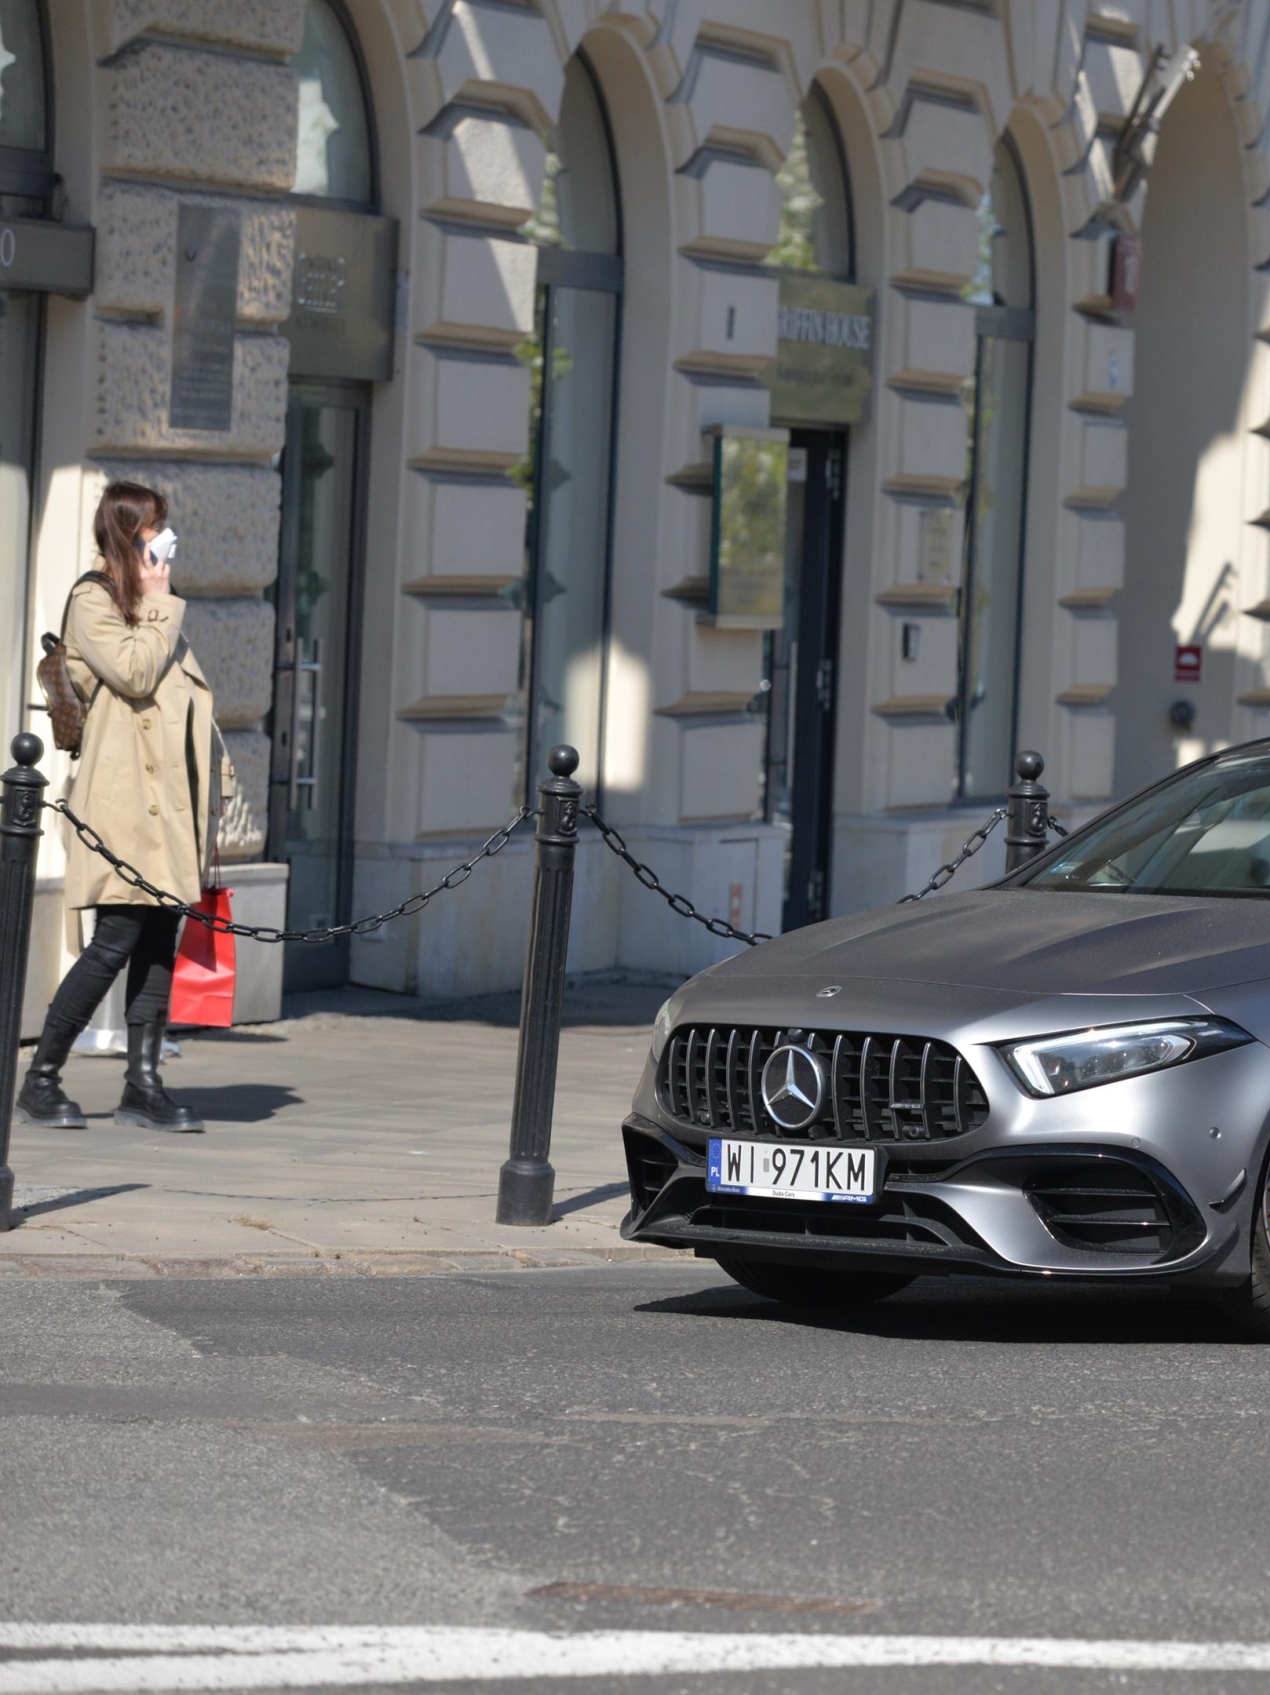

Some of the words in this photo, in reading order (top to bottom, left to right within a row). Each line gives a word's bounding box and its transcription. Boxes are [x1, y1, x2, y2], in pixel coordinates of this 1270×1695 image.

[711, 1166, 720, 1177] PL
[727, 1144, 754, 1183] WI
[772, 1148, 866, 1191] 971KM
